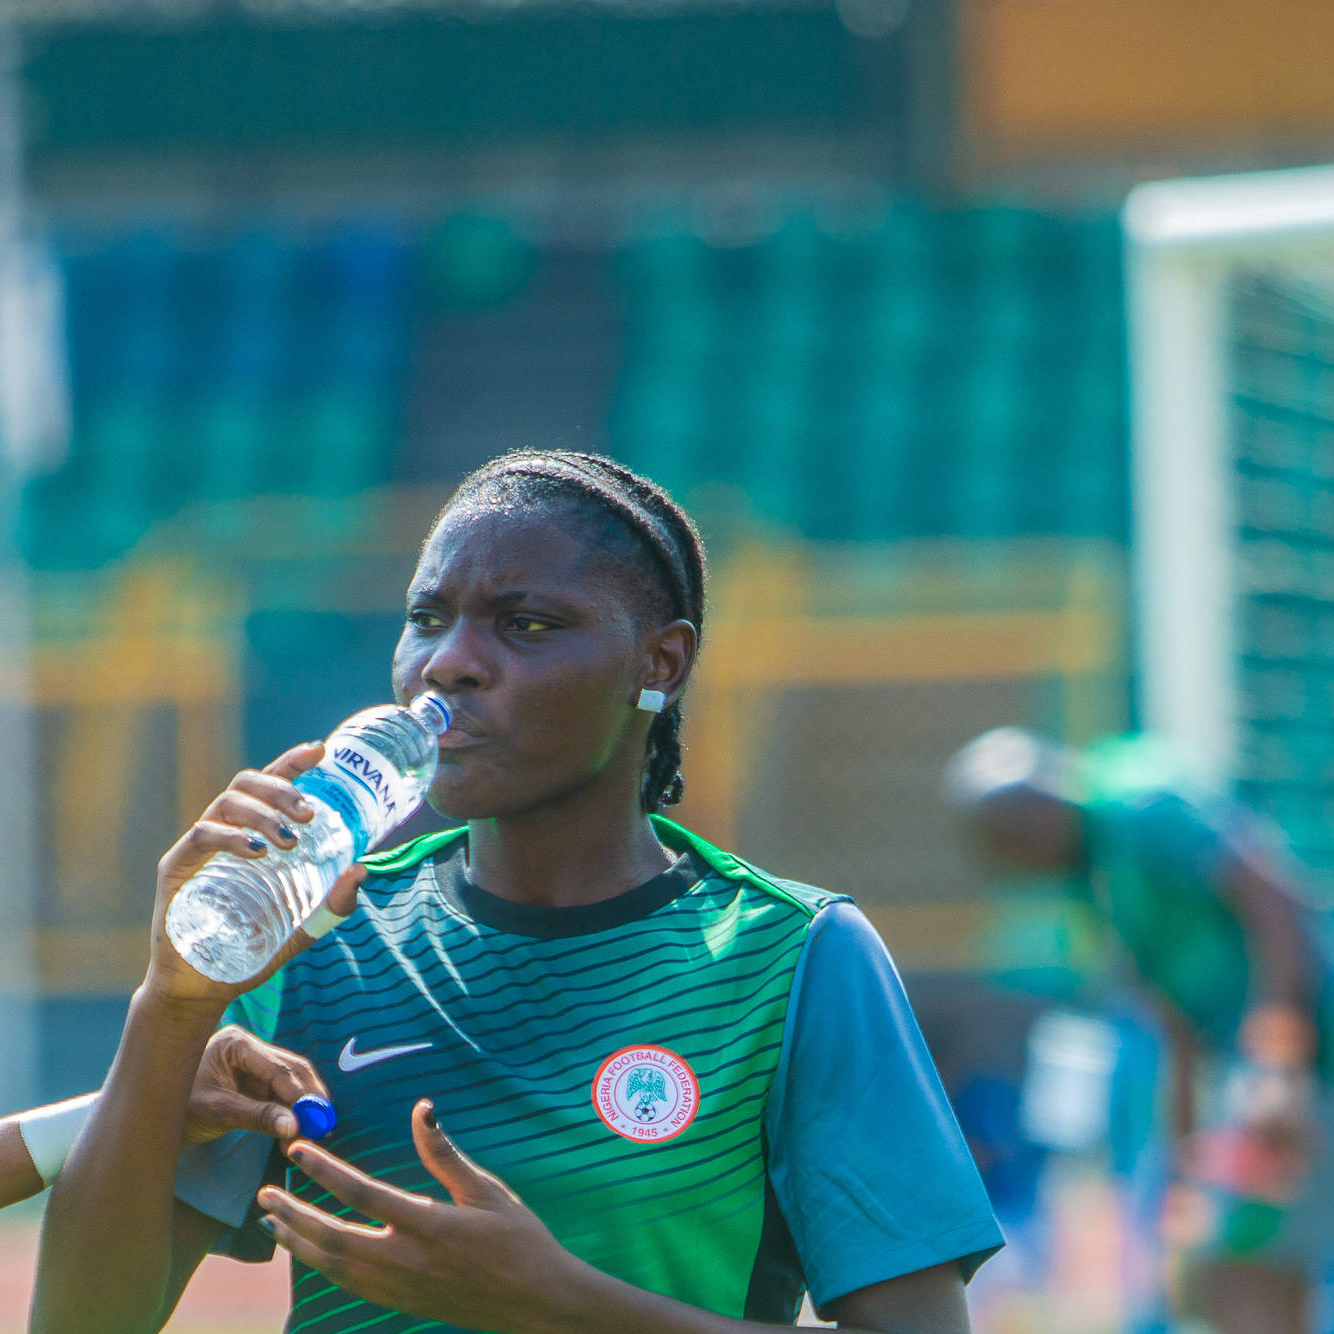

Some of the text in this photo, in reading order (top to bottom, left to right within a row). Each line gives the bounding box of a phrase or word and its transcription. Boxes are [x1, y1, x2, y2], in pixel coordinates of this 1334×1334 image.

[600, 1051, 692, 1128] NIGERIA FOOTBALL FEDERATION
[632, 1127, 658, 1137] 1945
